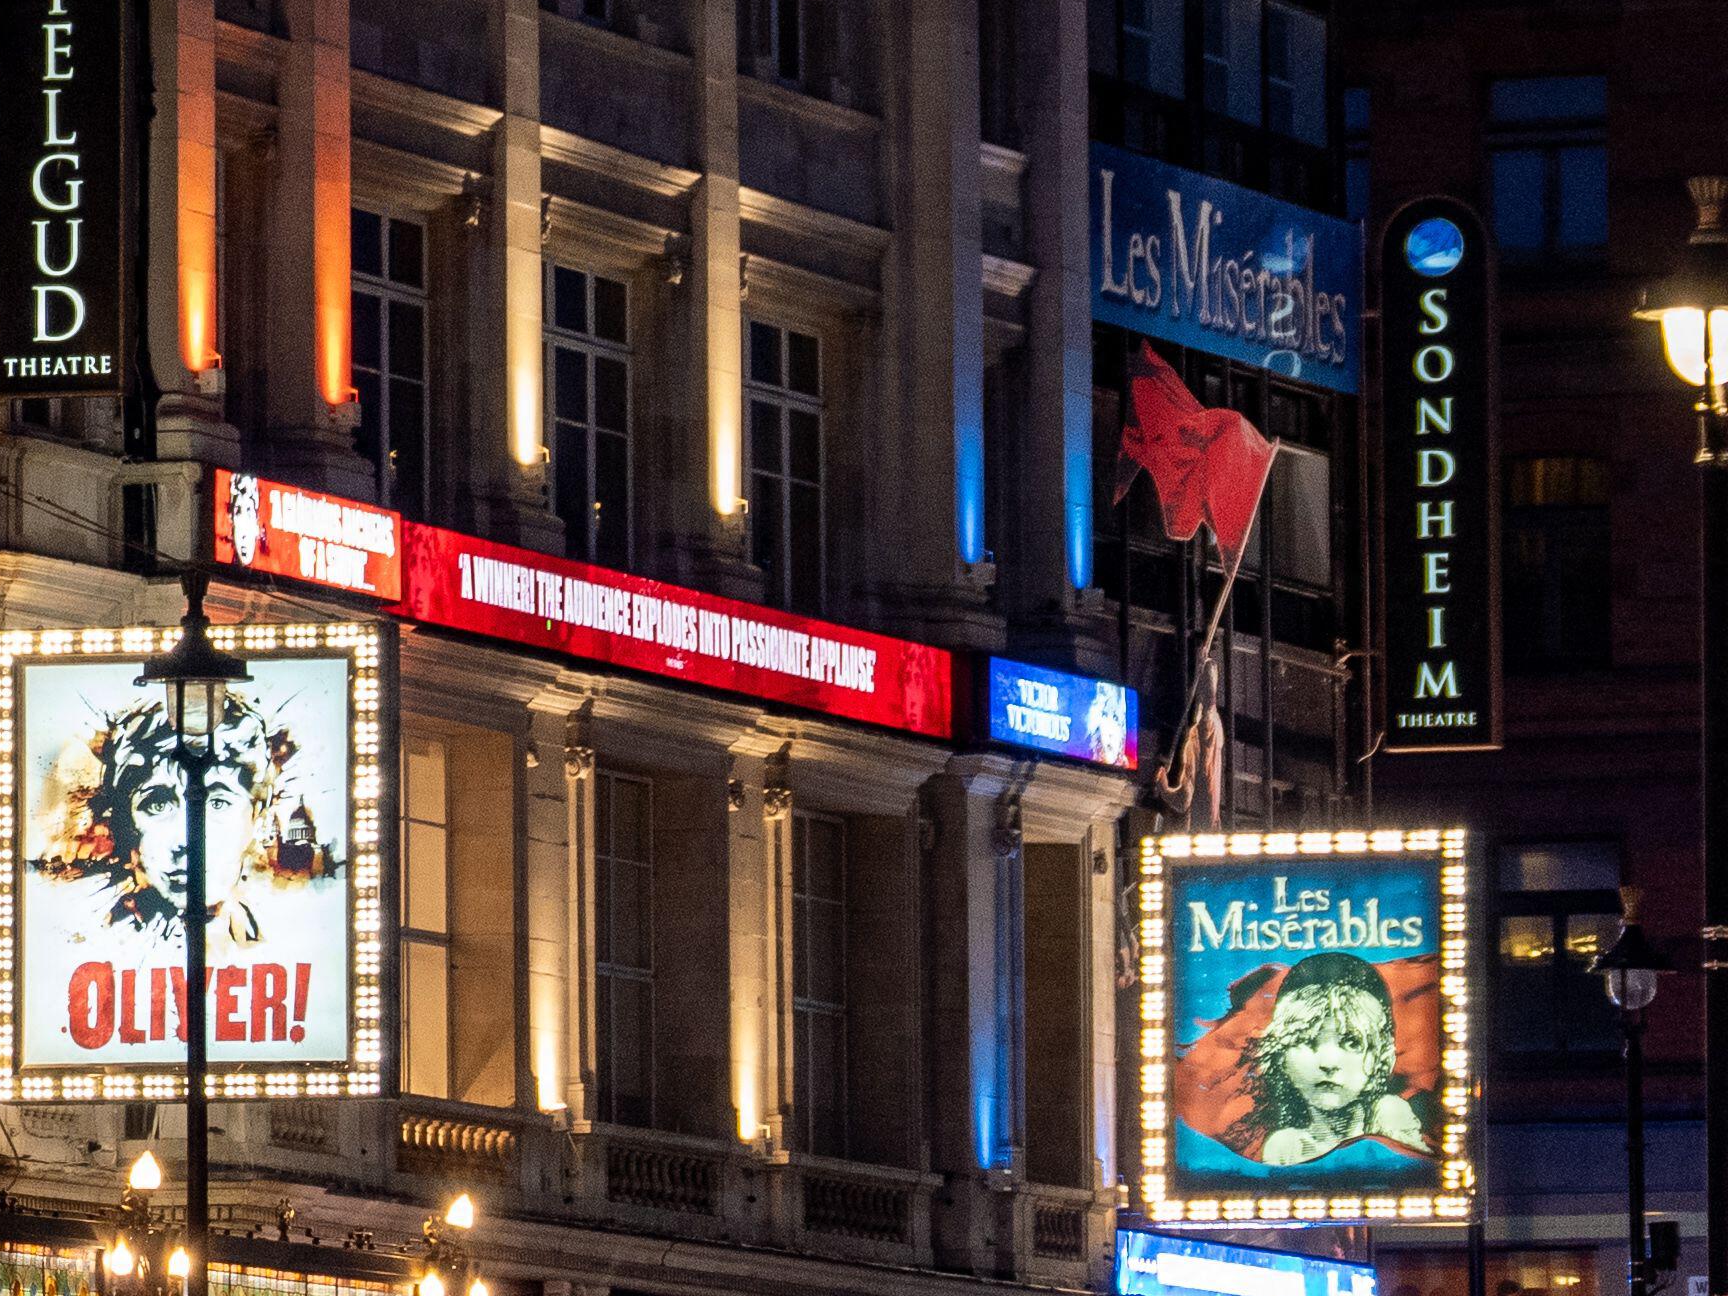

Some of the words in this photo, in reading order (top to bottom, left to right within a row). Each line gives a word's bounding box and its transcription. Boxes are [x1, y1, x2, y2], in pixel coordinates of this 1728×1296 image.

[1101, 168, 1161, 308] Les
[3, 355, 112, 377] THEATRE
[1412, 289, 1461, 699] SONDHEIM
[473, 556, 535, 614] WINNER!
[537, 570, 563, 621] THE
[564, 577, 631, 636] AUDIENCE
[632, 593, 697, 653] EXPLODES
[699, 609, 730, 660] INTO
[732, 617, 810, 678] PASSIONATE
[1398, 712, 1477, 727] THEATRE
[1273, 877, 1330, 913] Les
[1189, 898, 1423, 951] Misérables
